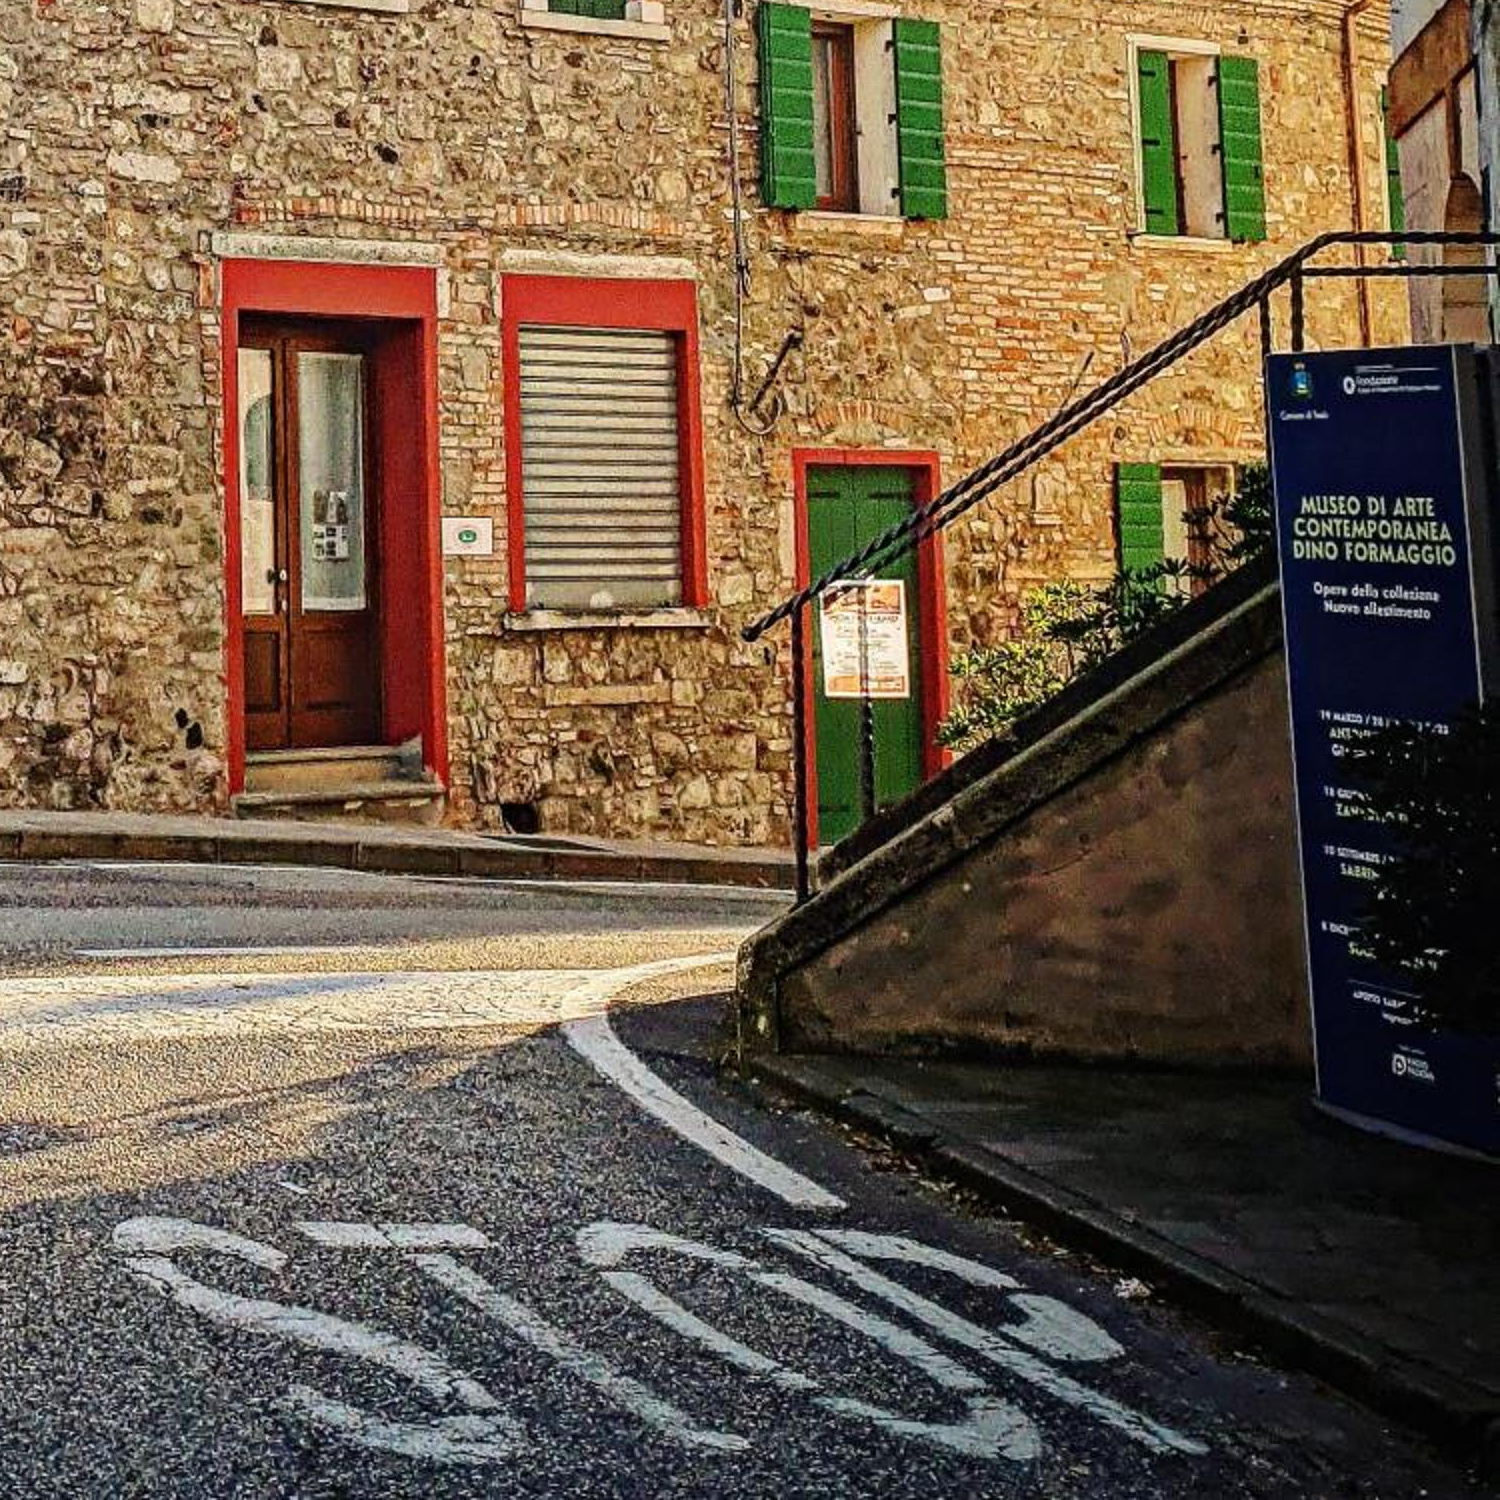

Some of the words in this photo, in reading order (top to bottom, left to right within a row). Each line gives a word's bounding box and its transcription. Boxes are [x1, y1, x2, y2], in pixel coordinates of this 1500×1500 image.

[1301, 495, 1361, 516] MUSEO
[1367, 496, 1386, 517] DI
[1393, 497, 1435, 517] ARTE
[1293, 517, 1453, 542] CONTEMPORANEA
[1293, 540, 1338, 560] DINO
[1345, 542, 1456, 566] FORMAGGIO
[1313, 581, 1348, 597] Opere
[1351, 583, 1379, 598] della
[1382, 585, 1440, 602] collezione
[1324, 600, 1360, 614] Nuovo
[1363, 602, 1431, 620] allestimento
[111, 1217, 1212, 1465] STOP
